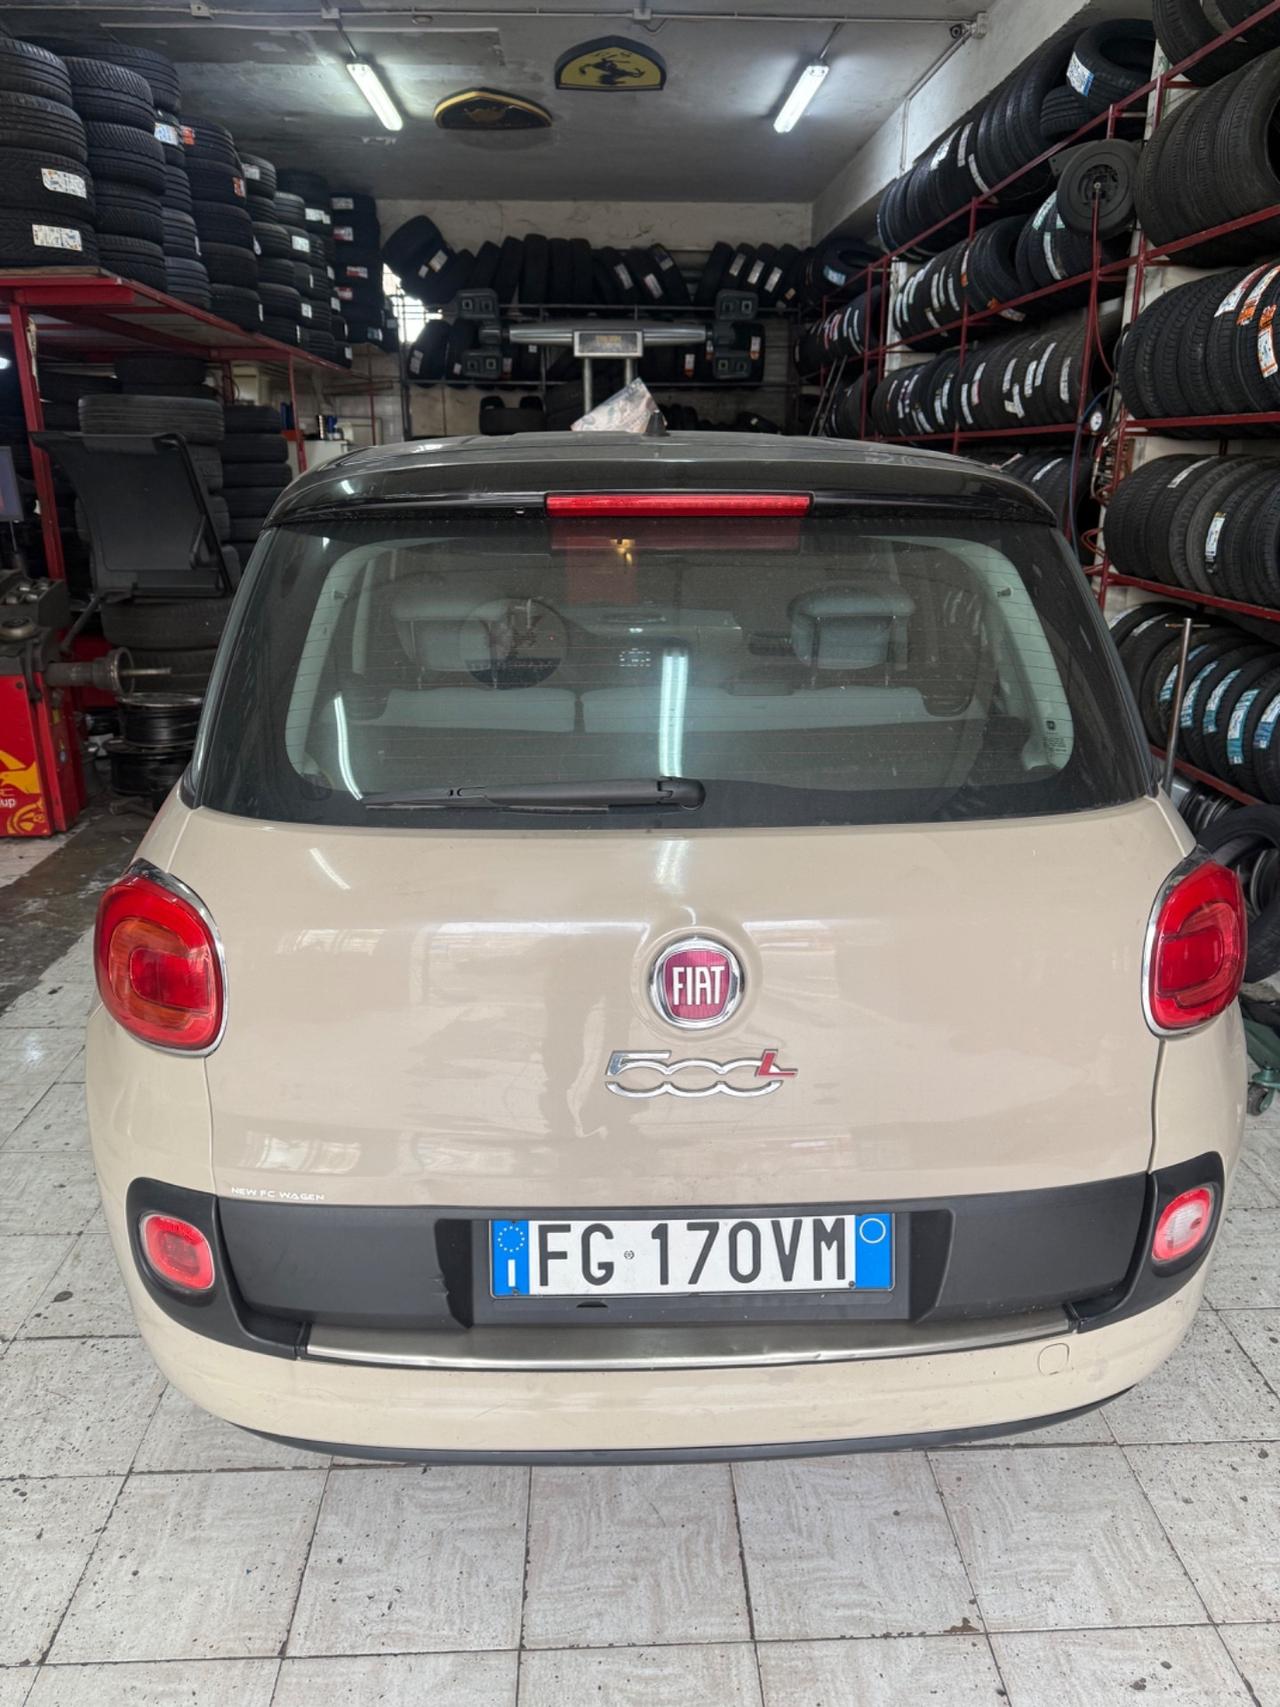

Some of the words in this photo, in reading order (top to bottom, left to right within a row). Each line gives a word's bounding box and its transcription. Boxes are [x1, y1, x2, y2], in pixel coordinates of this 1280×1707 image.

[672, 966, 725, 1005] FIAT
[605, 1049, 798, 1098] 500L
[231, 1187, 257, 1197] NEW
[260, 1189, 276, 1198] FC
[280, 1191, 325, 1201] WAGEN
[538, 1223, 615, 1286] FG
[651, 1218, 846, 1285] 170VM
